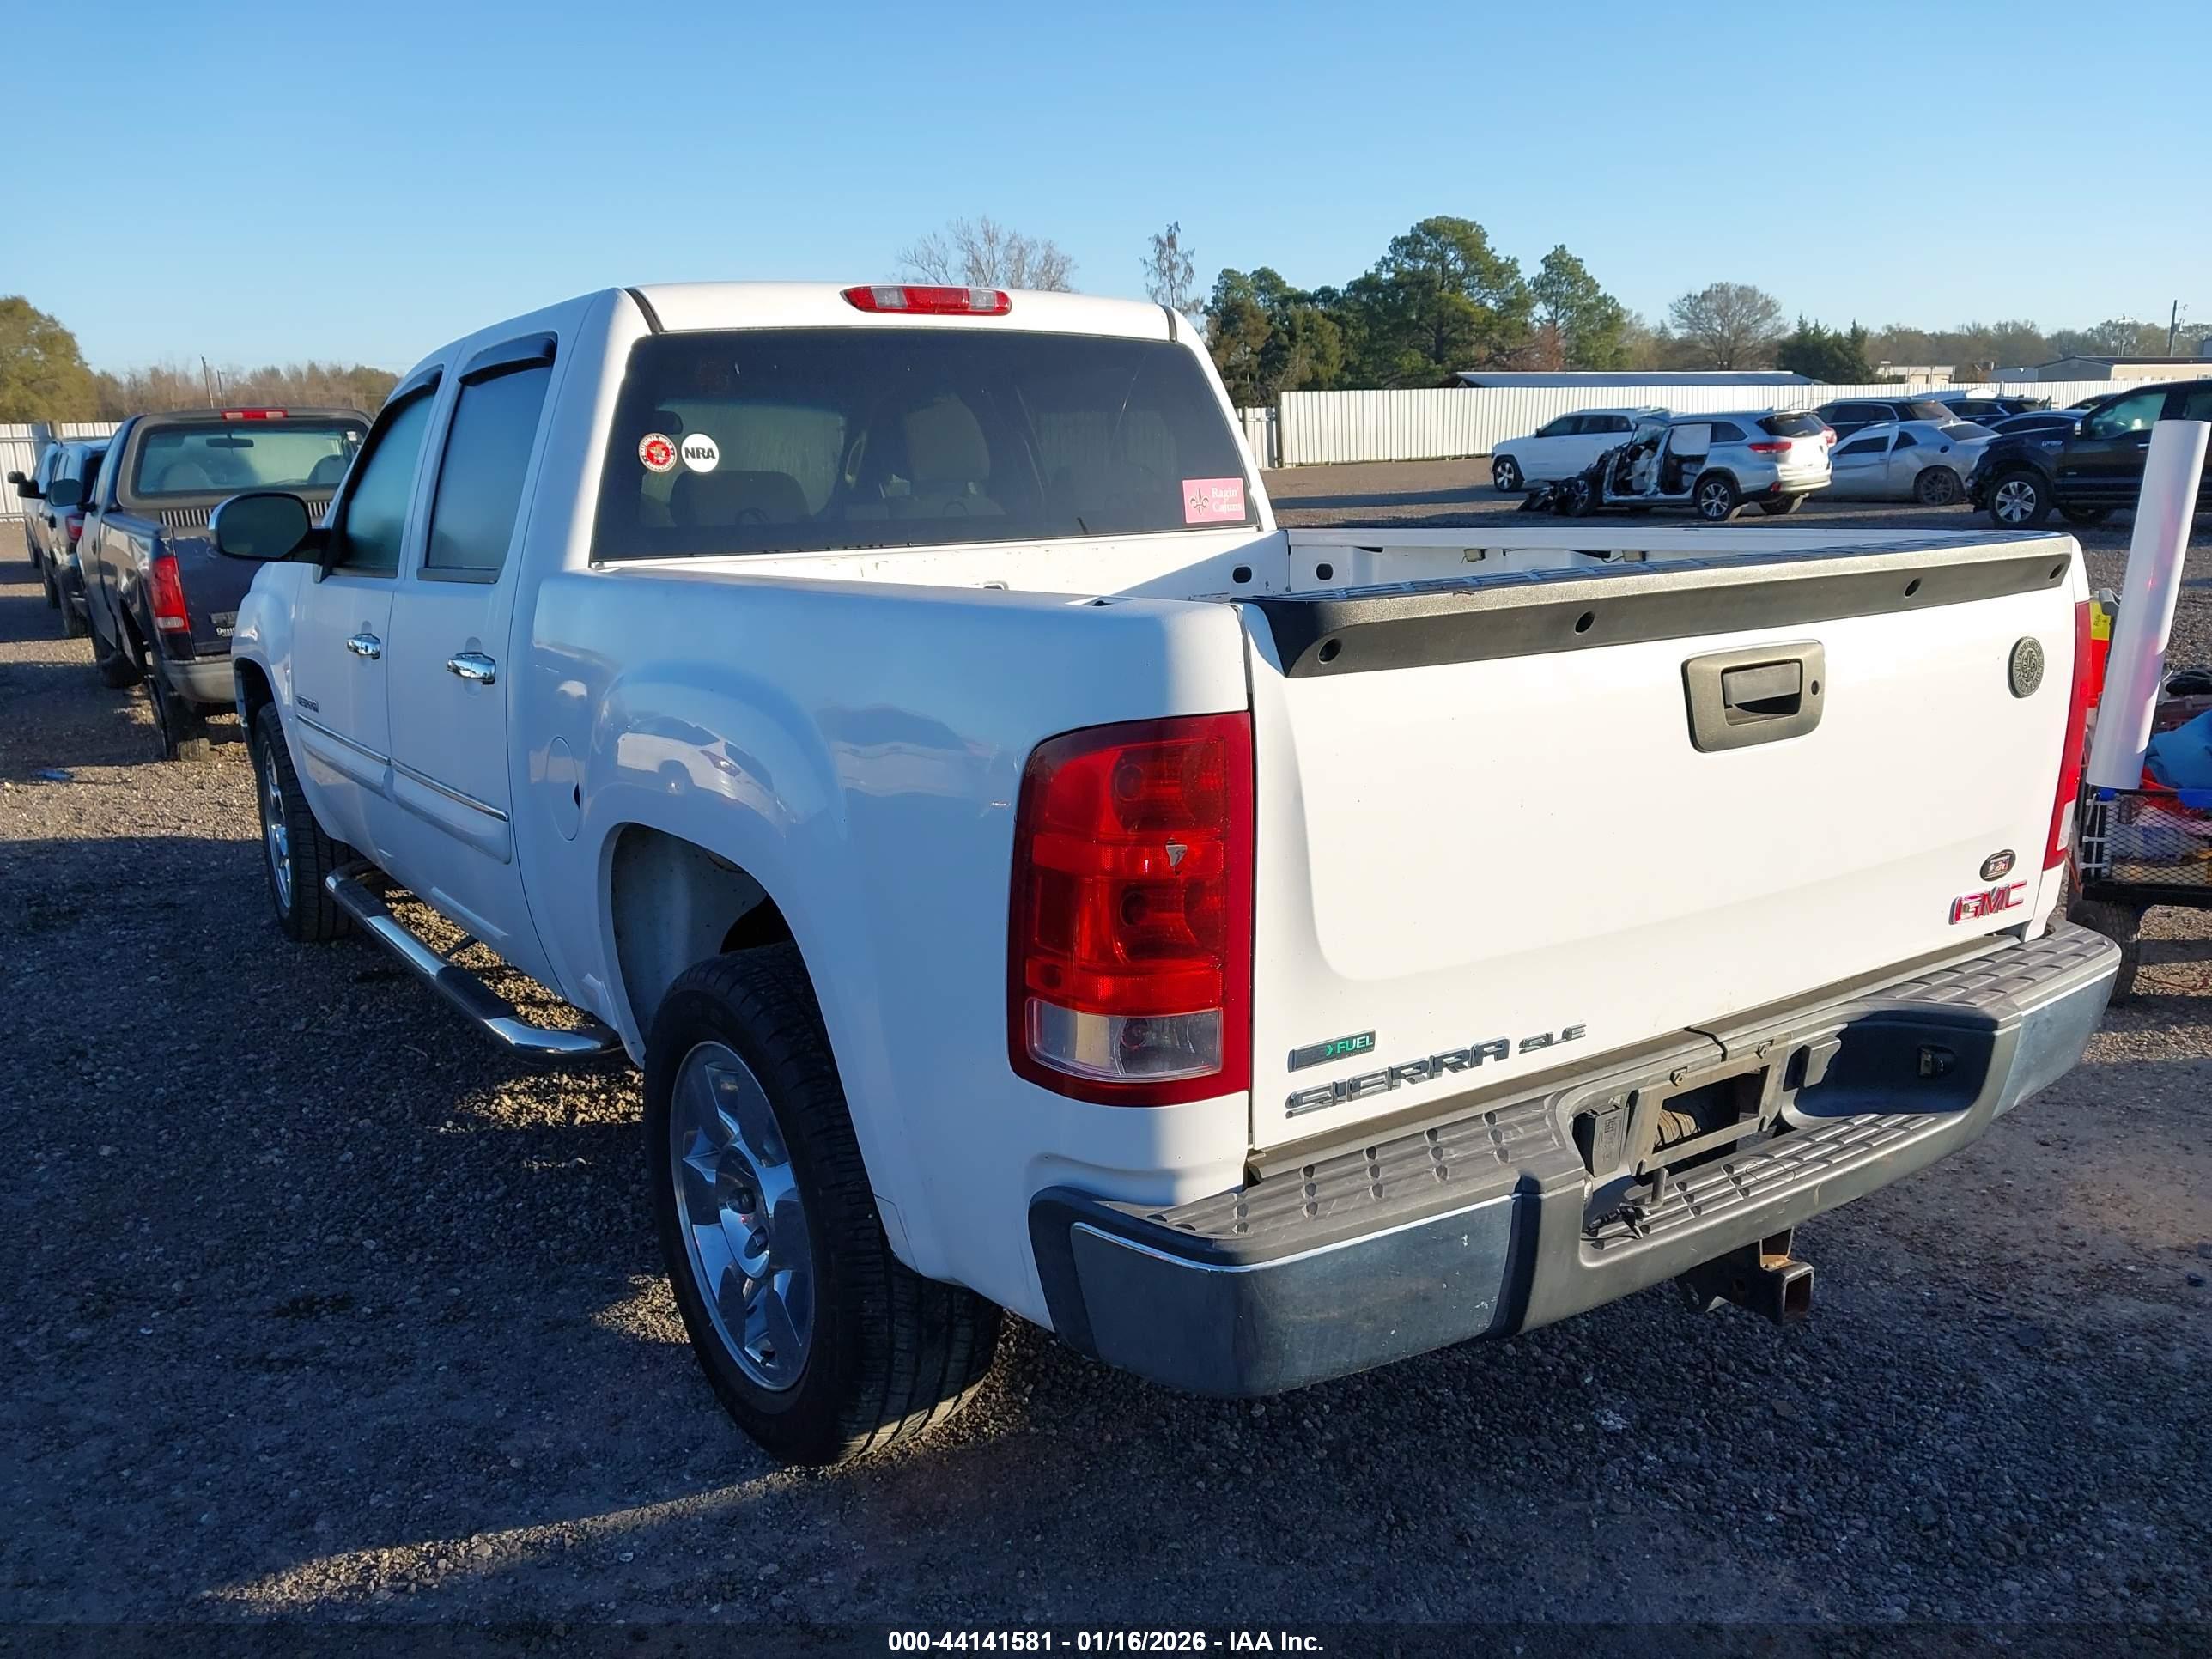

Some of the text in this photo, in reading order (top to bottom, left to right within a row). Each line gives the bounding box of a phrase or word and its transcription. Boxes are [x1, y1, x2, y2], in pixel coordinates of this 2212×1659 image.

[684, 447, 716, 459] NRA
[1948, 880, 2027, 925] GMC
[1337, 1035, 1374, 1054] FUEL
[1285, 1024, 1586, 1119] SIERRA SLE
